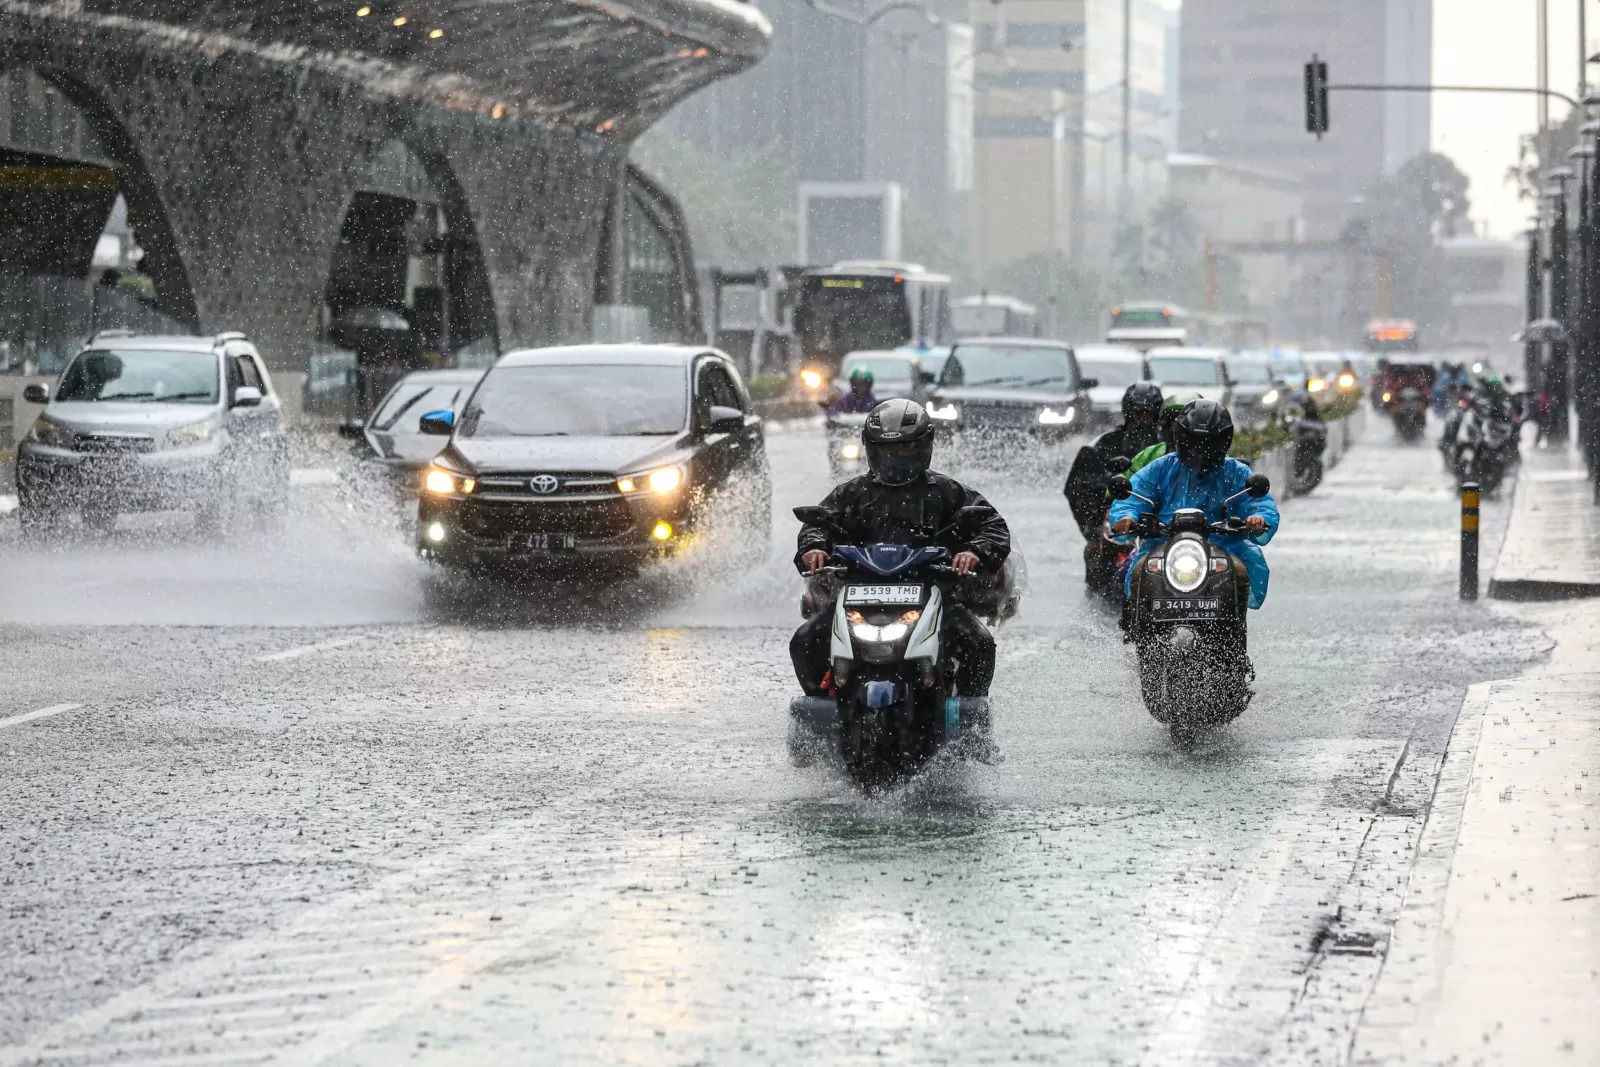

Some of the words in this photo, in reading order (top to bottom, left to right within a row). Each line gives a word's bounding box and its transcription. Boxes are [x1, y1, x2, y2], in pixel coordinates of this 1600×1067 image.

[850, 587, 856, 595] B
[863, 587, 891, 595] 5539
[897, 586, 918, 595] TMB
[1153, 600, 1160, 609] B
[1166, 600, 1191, 609] 3419
